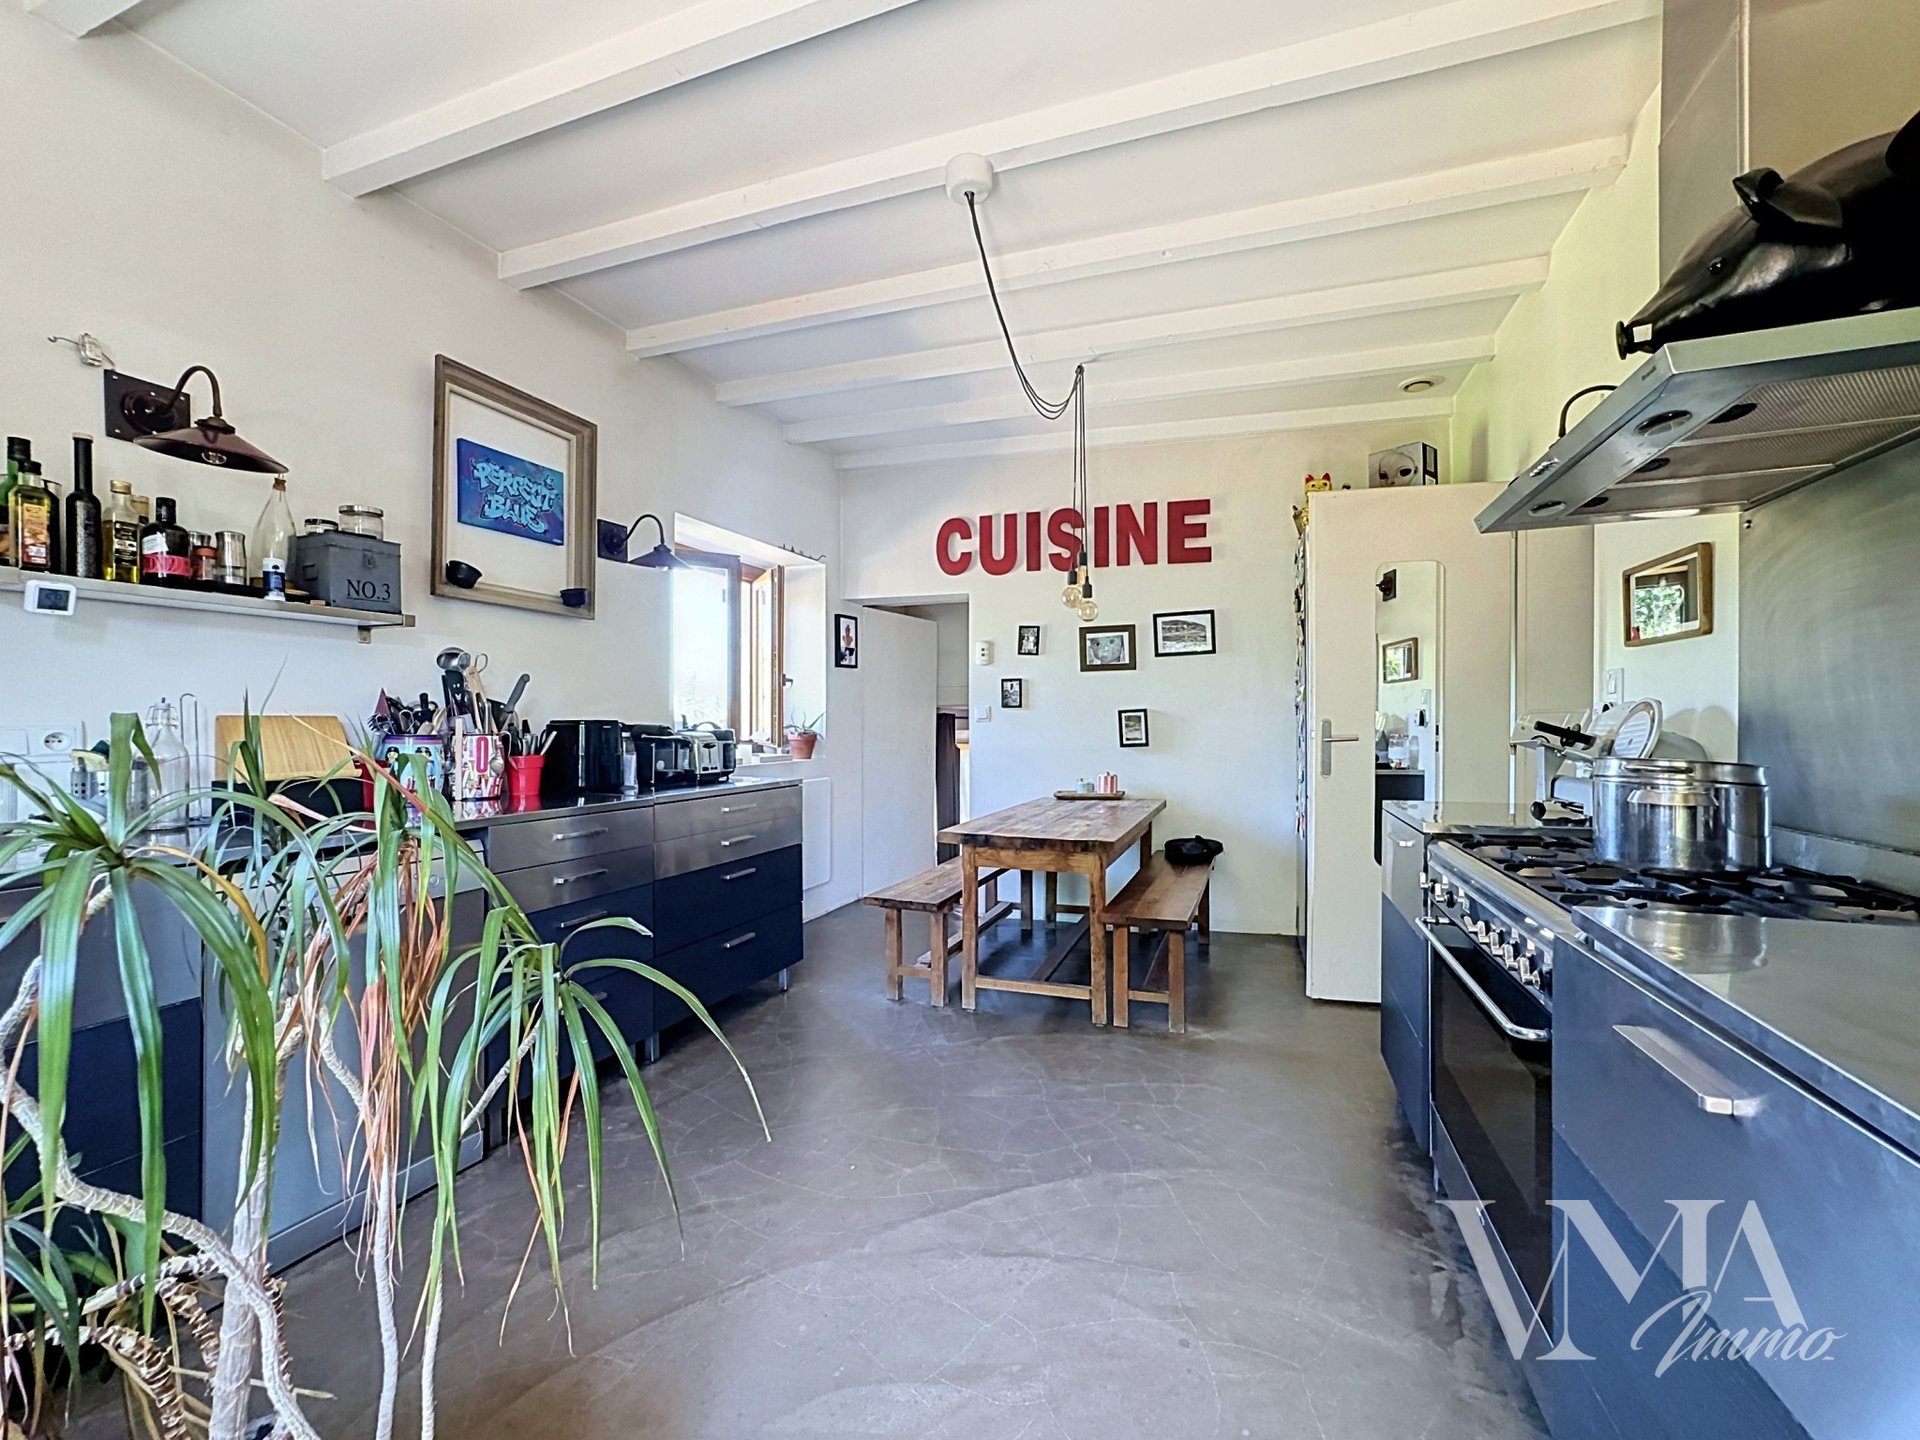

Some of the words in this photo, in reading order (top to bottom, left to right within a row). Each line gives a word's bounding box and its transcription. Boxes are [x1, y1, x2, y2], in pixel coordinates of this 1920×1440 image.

[471, 459, 557, 511] PERFECT
[481, 493, 547, 534] BLUE
[935, 498, 1213, 576] CUISINE
[346, 578, 391, 601] NO.3
